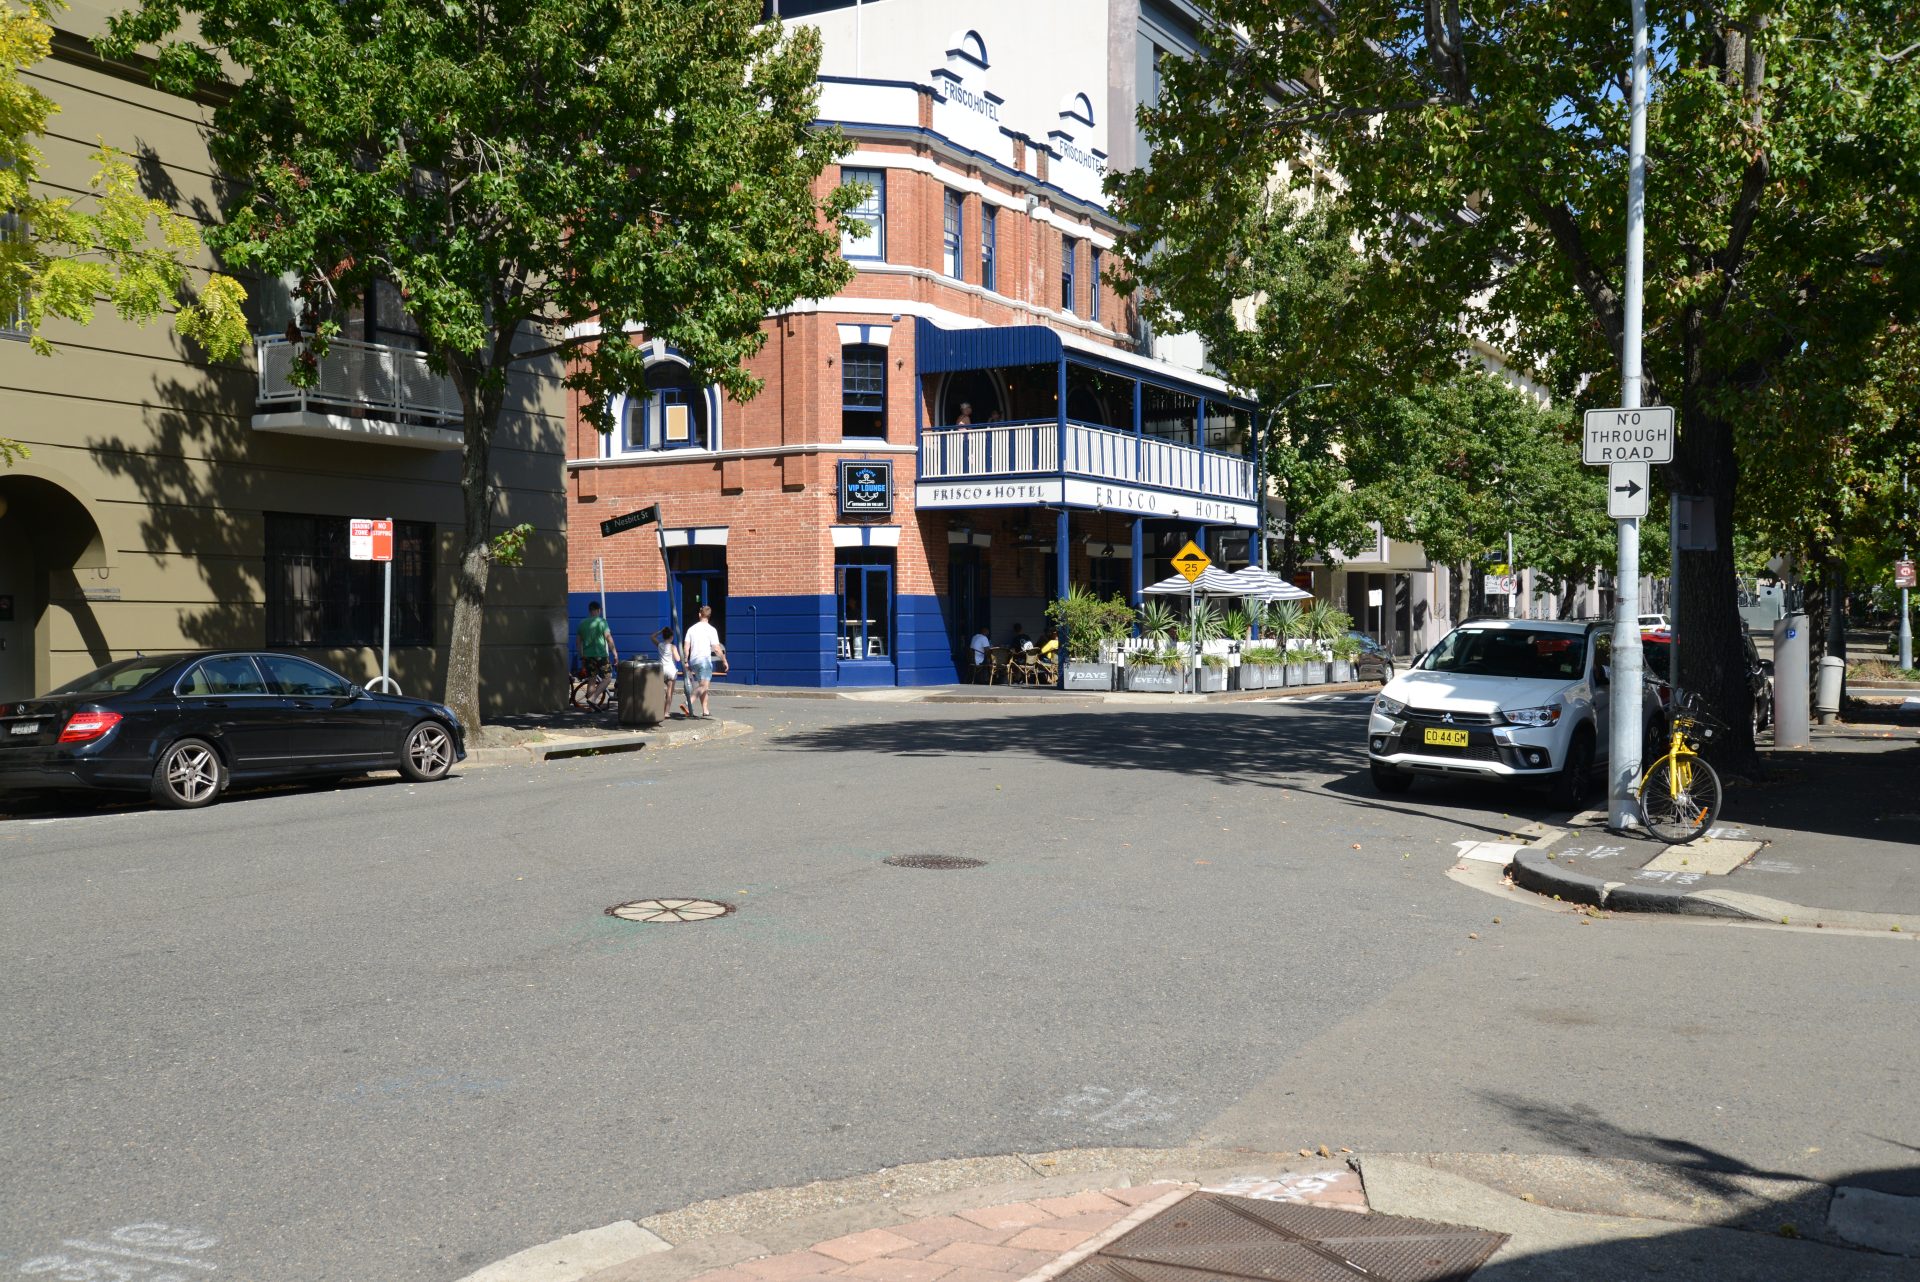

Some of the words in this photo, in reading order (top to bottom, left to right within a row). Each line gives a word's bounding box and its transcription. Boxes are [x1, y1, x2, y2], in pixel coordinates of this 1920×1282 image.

[944, 80, 973, 109] FRISCO
[973, 94, 999, 122] HOTEL
[1059, 139, 1083, 164] FRISCO
[1617, 412, 1641, 425] NO
[1591, 429, 1667, 443] THROUGH
[1602, 446, 1654, 459] ROAD
[848, 484, 860, 492] VIP
[861, 484, 886, 492] LOUNGE
[933, 488, 982, 501] FRISCO
[995, 485, 1045, 498] HOTEL
[1096, 487, 1156, 511] FRISCO
[614, 514, 641, 528] Nesbitt
[641, 511, 649, 519] St
[1184, 564, 1198, 573] 25
[1441, 732, 1452, 742] 44
